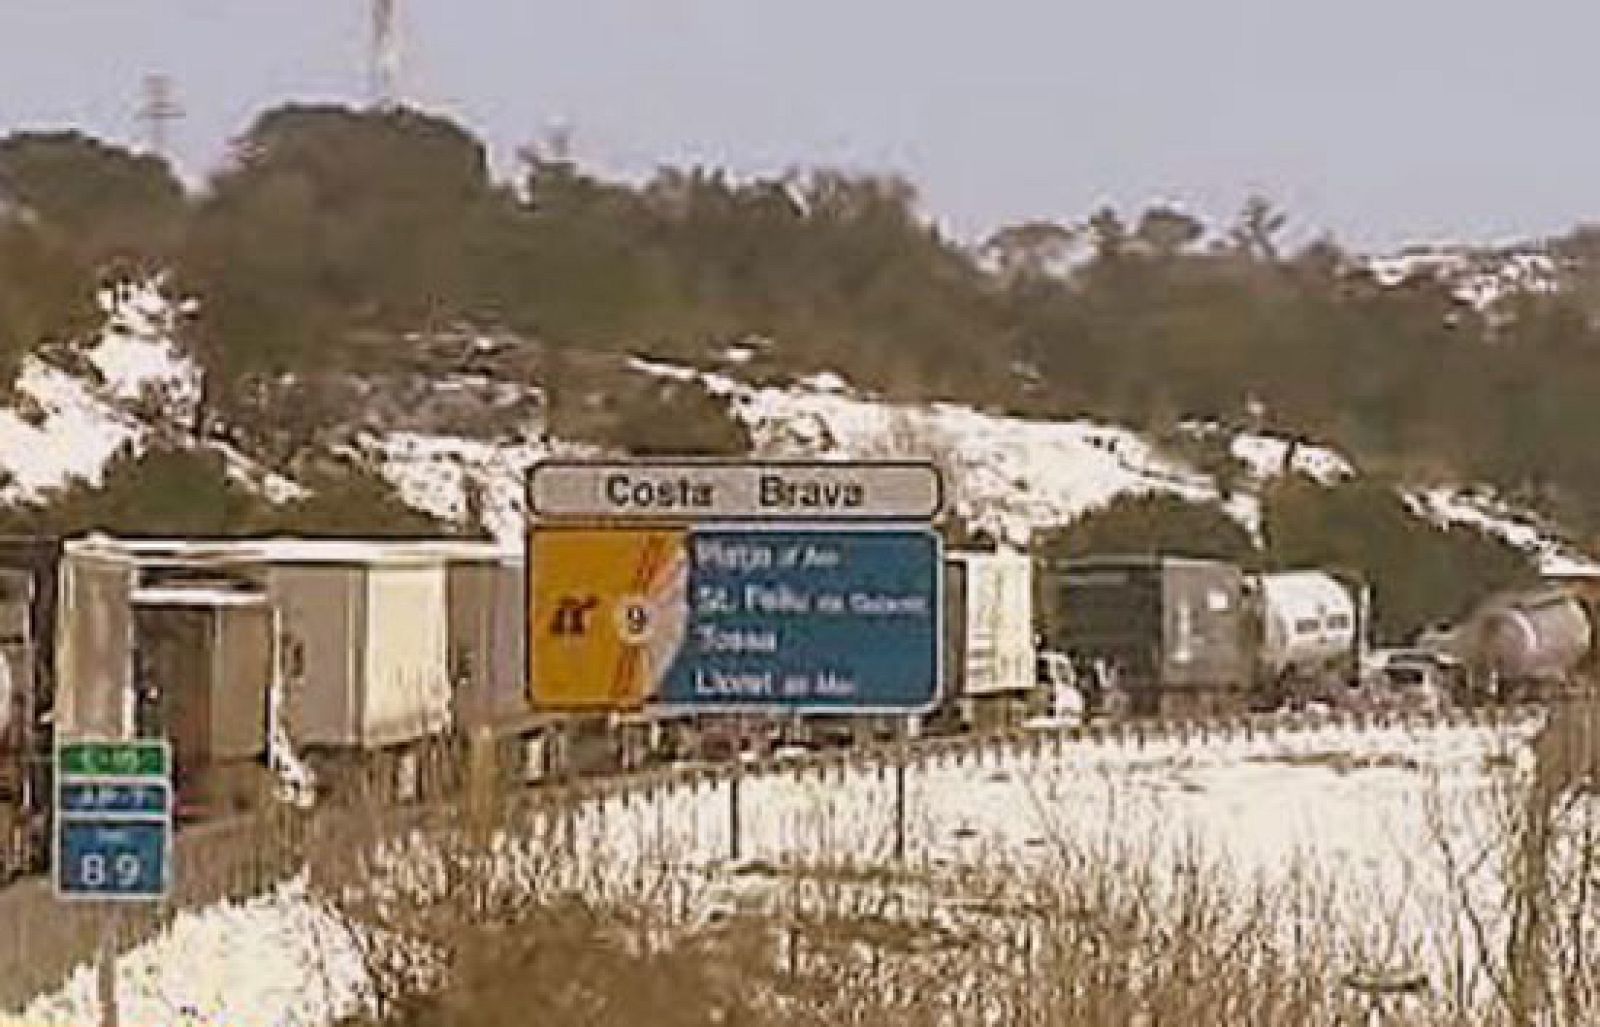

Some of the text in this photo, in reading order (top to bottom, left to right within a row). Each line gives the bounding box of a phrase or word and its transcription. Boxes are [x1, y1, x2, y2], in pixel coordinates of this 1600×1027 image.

[605, 474, 865, 506] Costa Brava
[628, 605, 647, 635] 9
[698, 624, 777, 651] Tossa
[81, 854, 141, 888] 89
